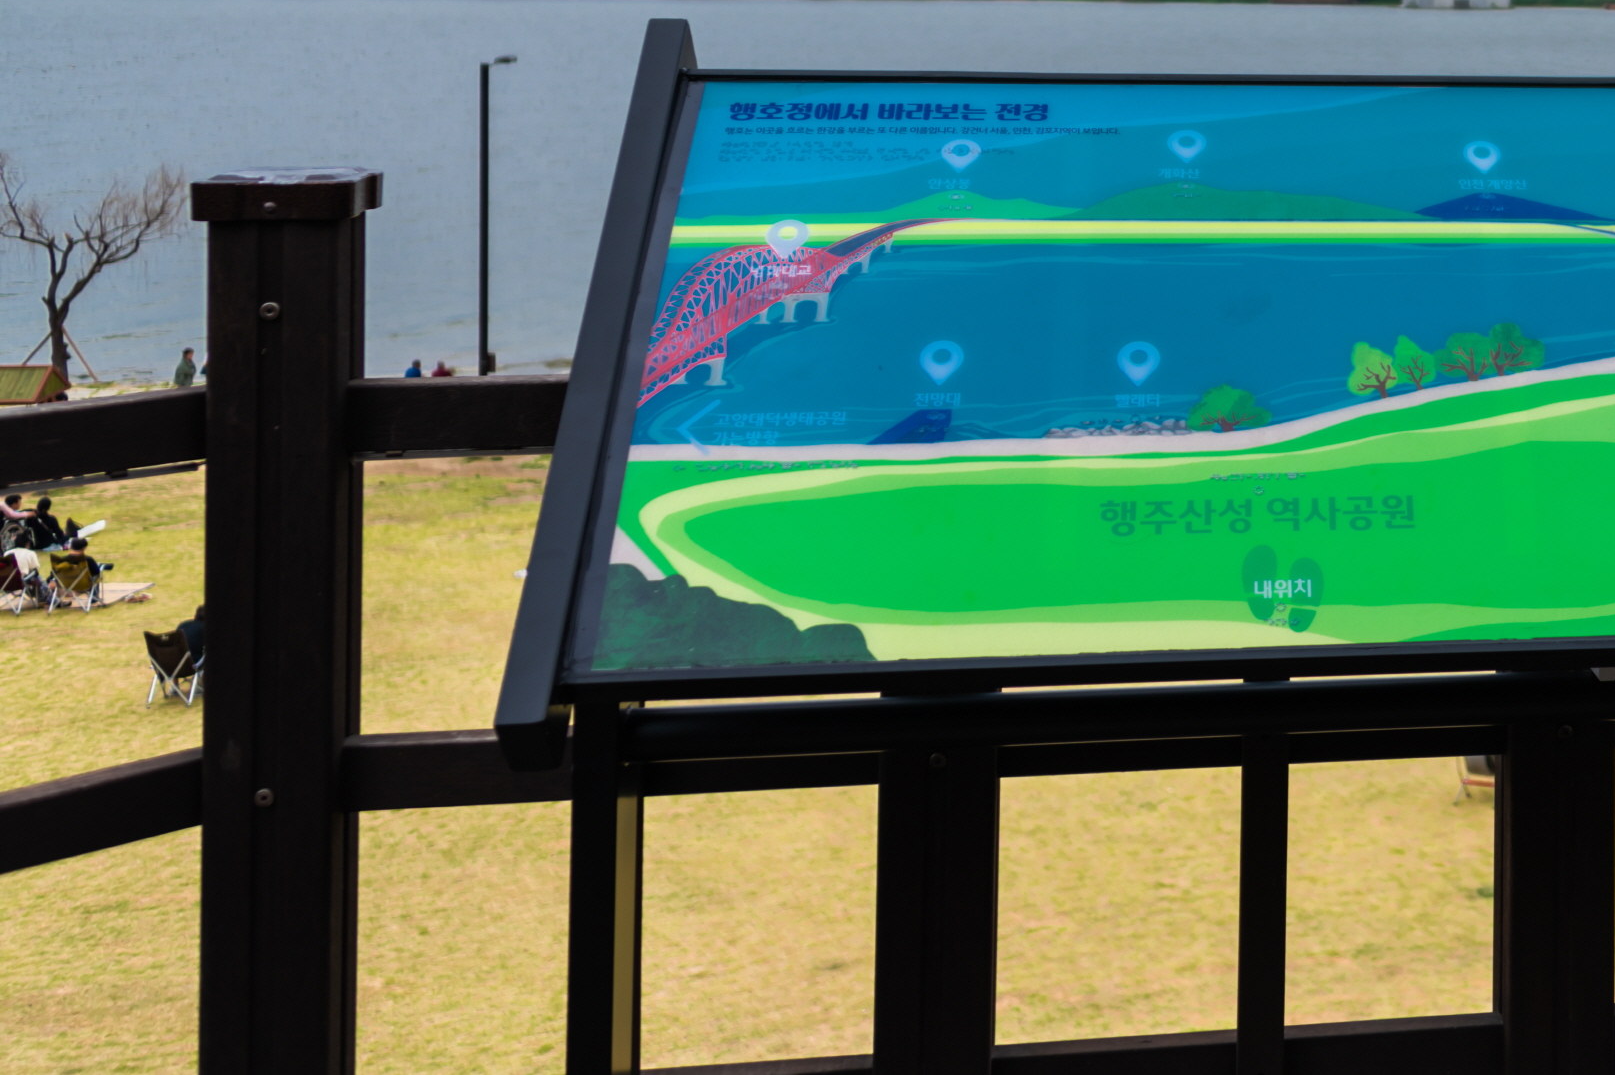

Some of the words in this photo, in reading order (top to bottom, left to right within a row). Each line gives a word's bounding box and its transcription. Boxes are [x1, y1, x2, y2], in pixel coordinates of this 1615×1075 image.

[729, 102, 869, 121] 행호정에서
[877, 102, 988, 121] 바라보는
[994, 103, 1049, 122] 전경
[725, 126, 753, 135] 행호는
[756, 126, 783, 135] 이곳을
[785, 126, 814, 135] 흐르는
[816, 126, 845, 135] 한강을
[847, 126, 875, 135] 부르는
[877, 126, 886, 135] 또
[889, 126, 907, 135] 다른
[1158, 168, 1200, 179] 개화산
[1458, 179, 1484, 190] 인천
[1487, 179, 1527, 190] 계양산
[913, 392, 961, 407] 전망대
[713, 411, 847, 428] 고양대덕생태공원
[711, 430, 780, 446] 가는방향
[1100, 498, 1253, 537] 행주산성
[1265, 495, 1416, 532] 역사공원
[1253, 578, 1312, 599] 내위치
